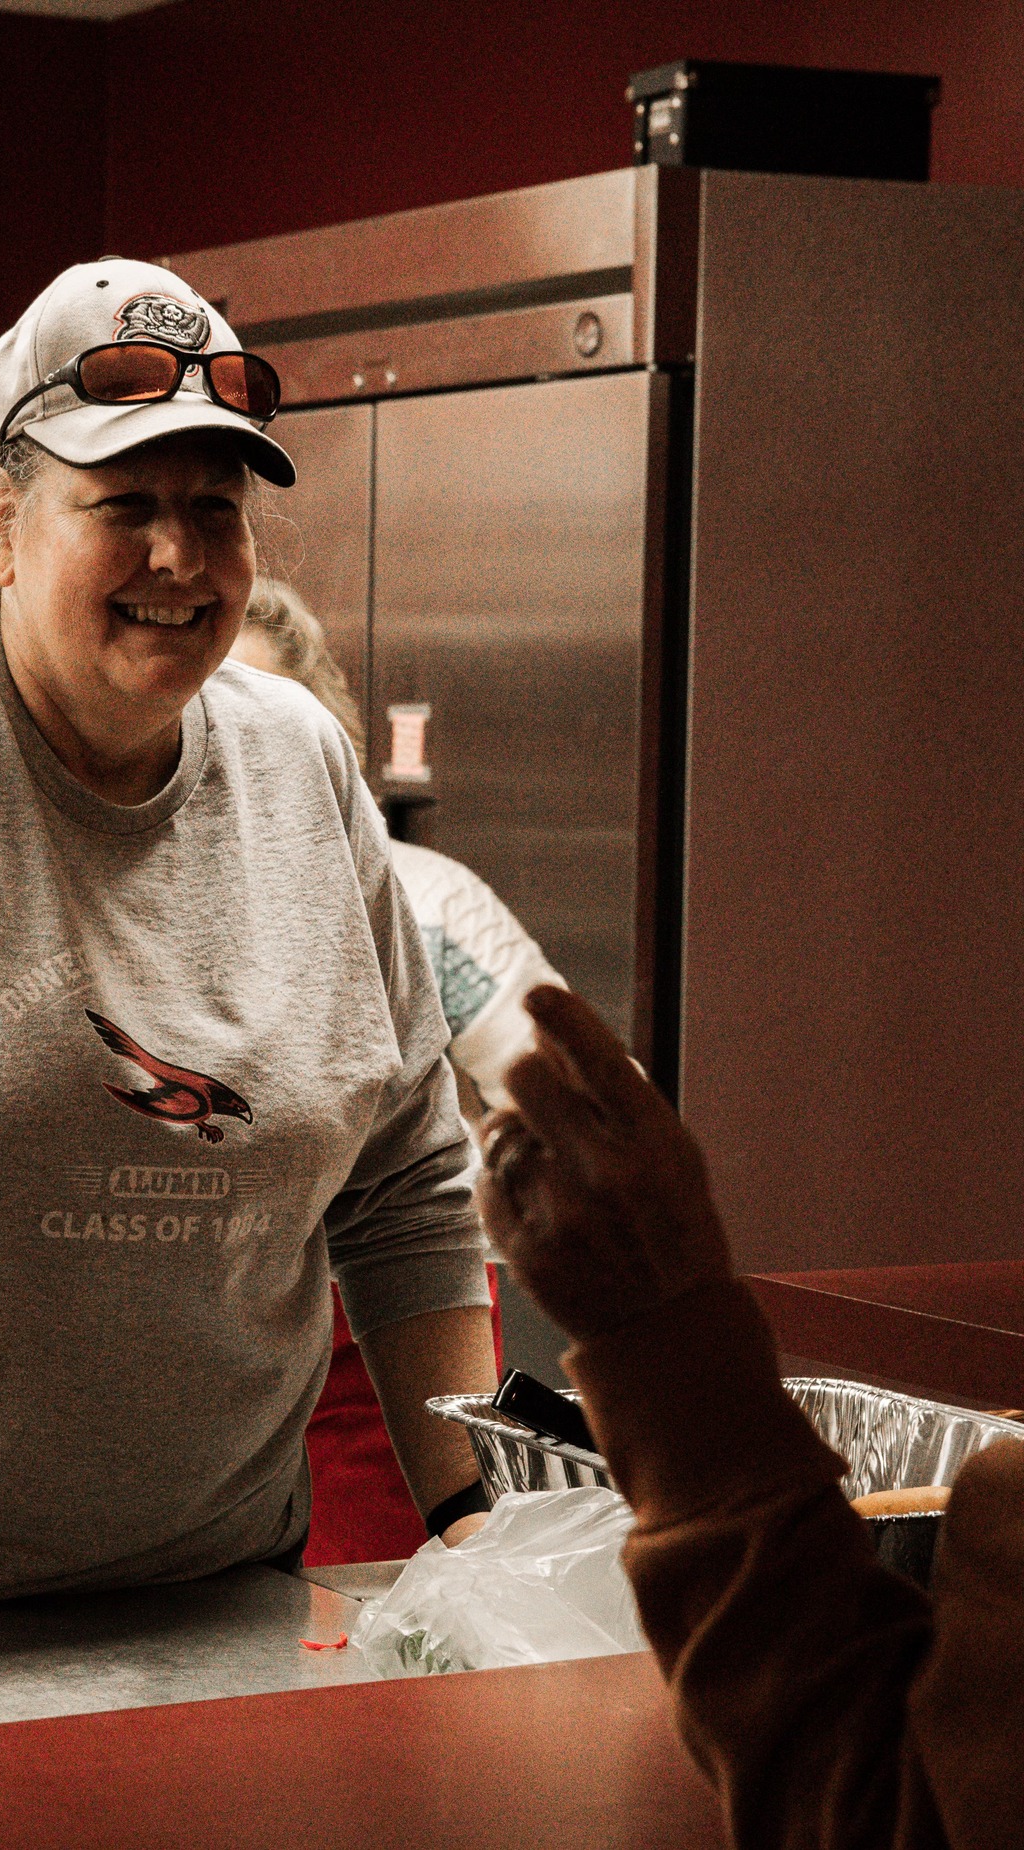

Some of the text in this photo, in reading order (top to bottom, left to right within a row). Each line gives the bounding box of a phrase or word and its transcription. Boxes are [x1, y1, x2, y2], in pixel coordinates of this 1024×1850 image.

[115, 1170, 225, 1196] ALUMNI
[40, 1210, 148, 1242] CLASS
[155, 1214, 202, 1243] OF
